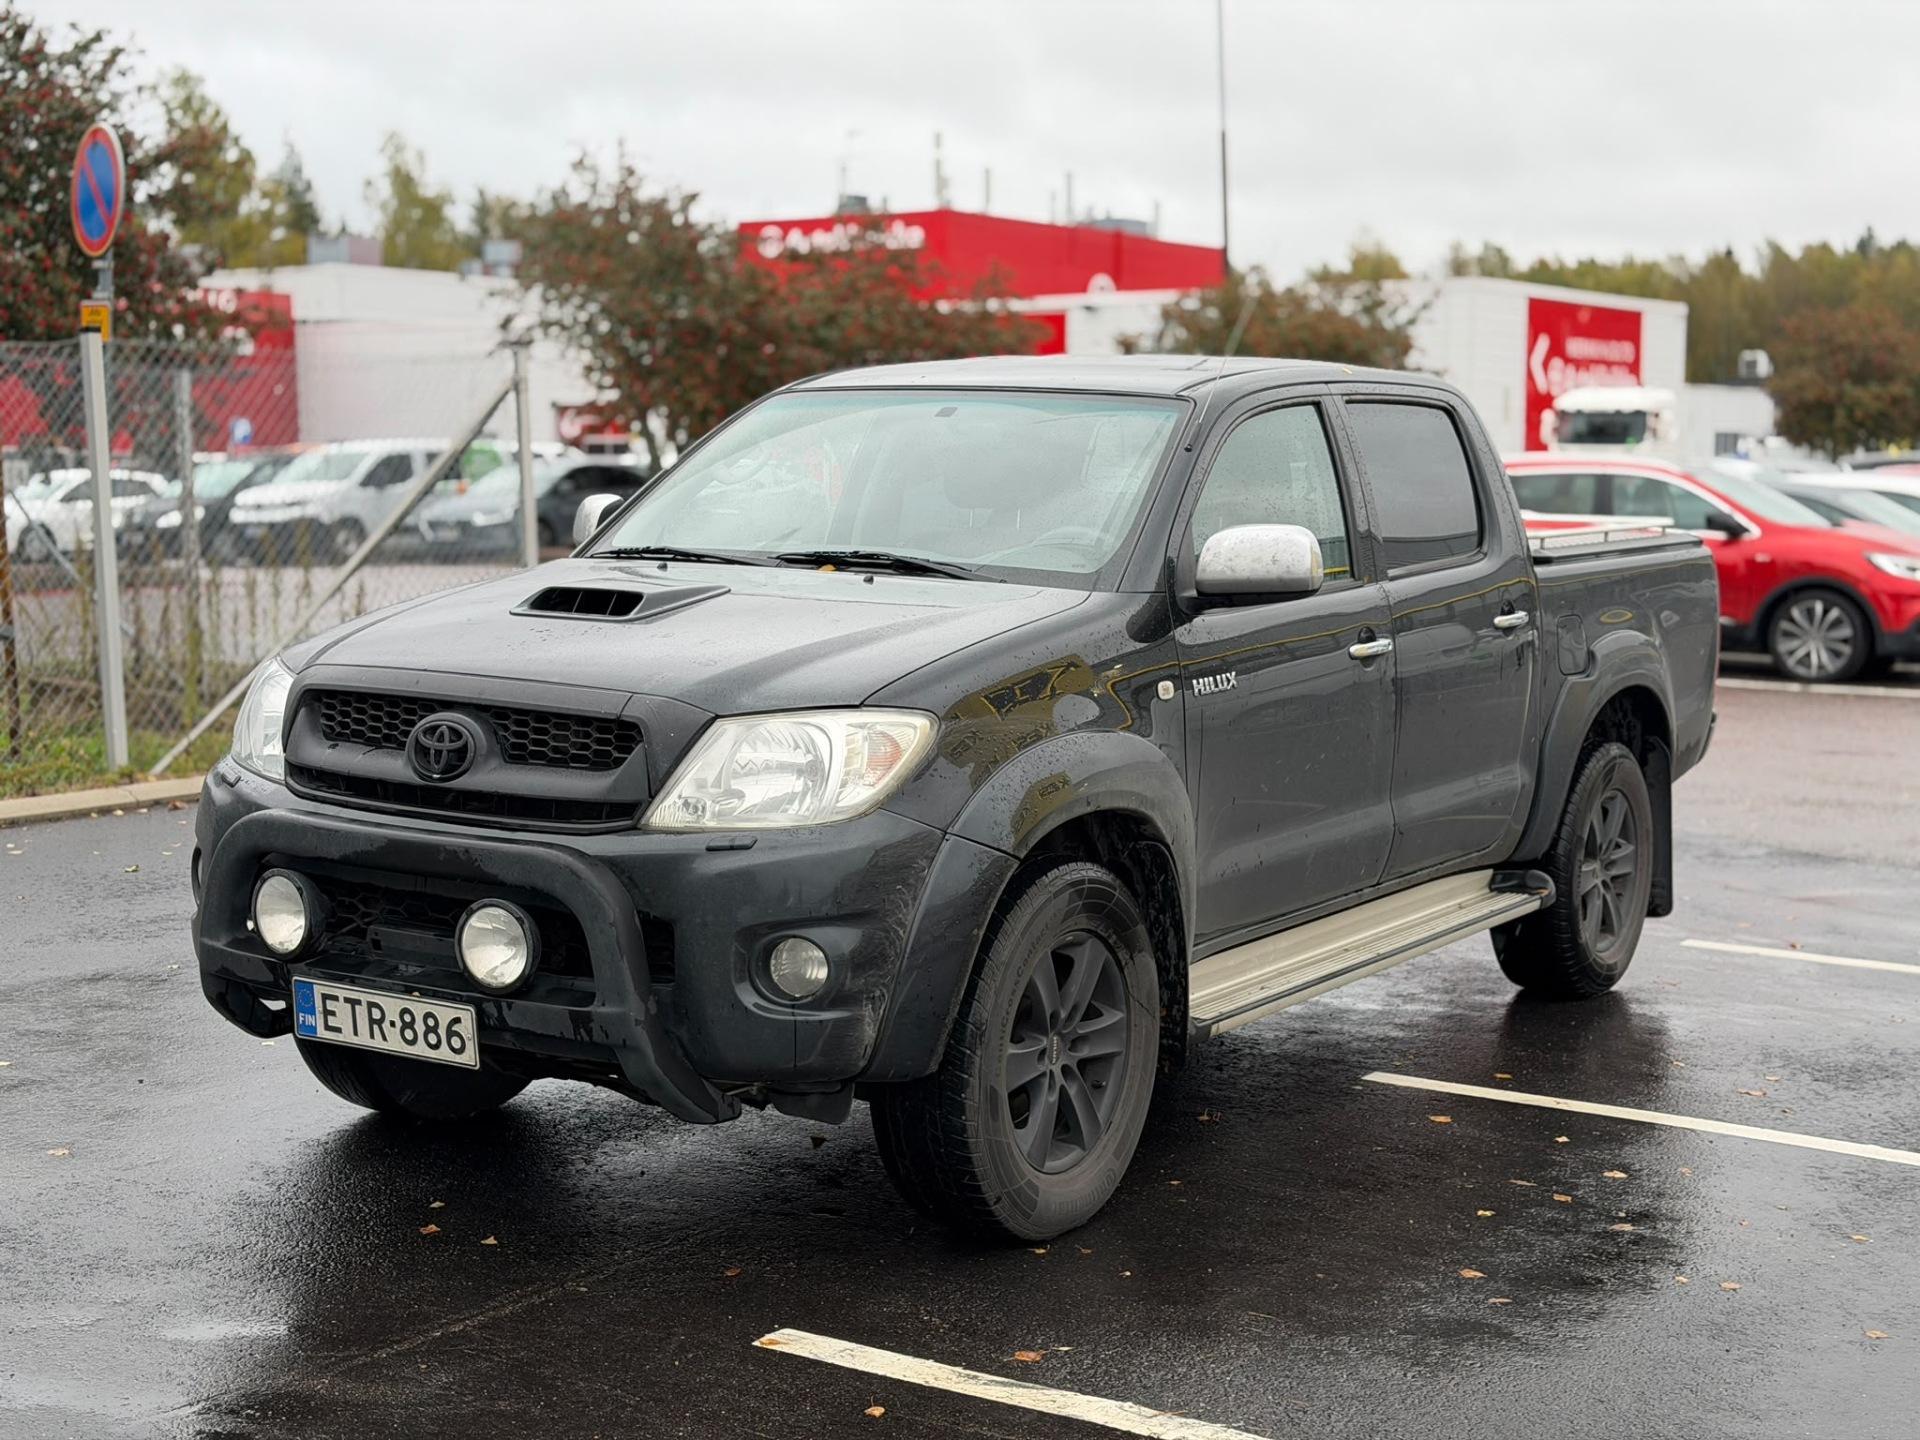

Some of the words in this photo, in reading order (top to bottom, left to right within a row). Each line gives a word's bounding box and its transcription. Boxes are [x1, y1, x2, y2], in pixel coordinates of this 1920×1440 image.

[1192, 671, 1238, 697] HILUX
[299, 1011, 316, 1028] FIN
[320, 992, 467, 1056] ETR-886
